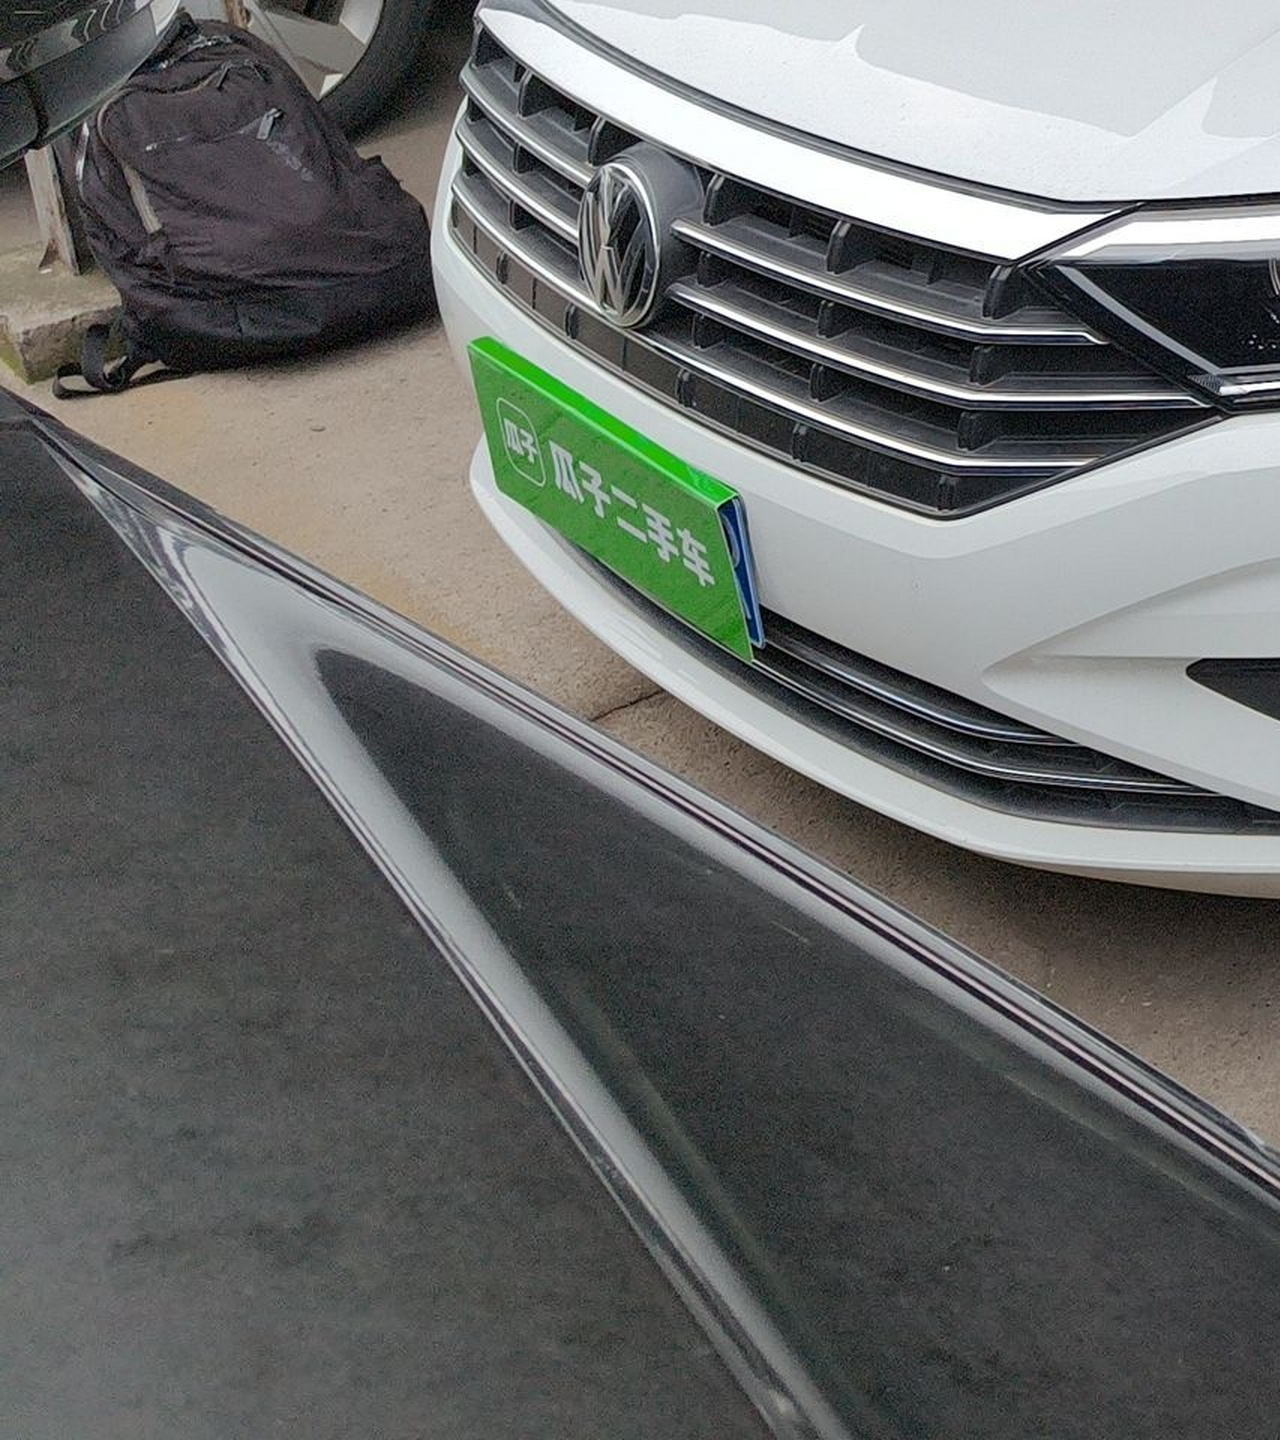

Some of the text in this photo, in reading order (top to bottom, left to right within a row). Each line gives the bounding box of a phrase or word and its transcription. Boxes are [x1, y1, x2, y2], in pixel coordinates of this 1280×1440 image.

[503, 418, 538, 464] 瓜子
[548, 440, 716, 588] 瓜子二手车
